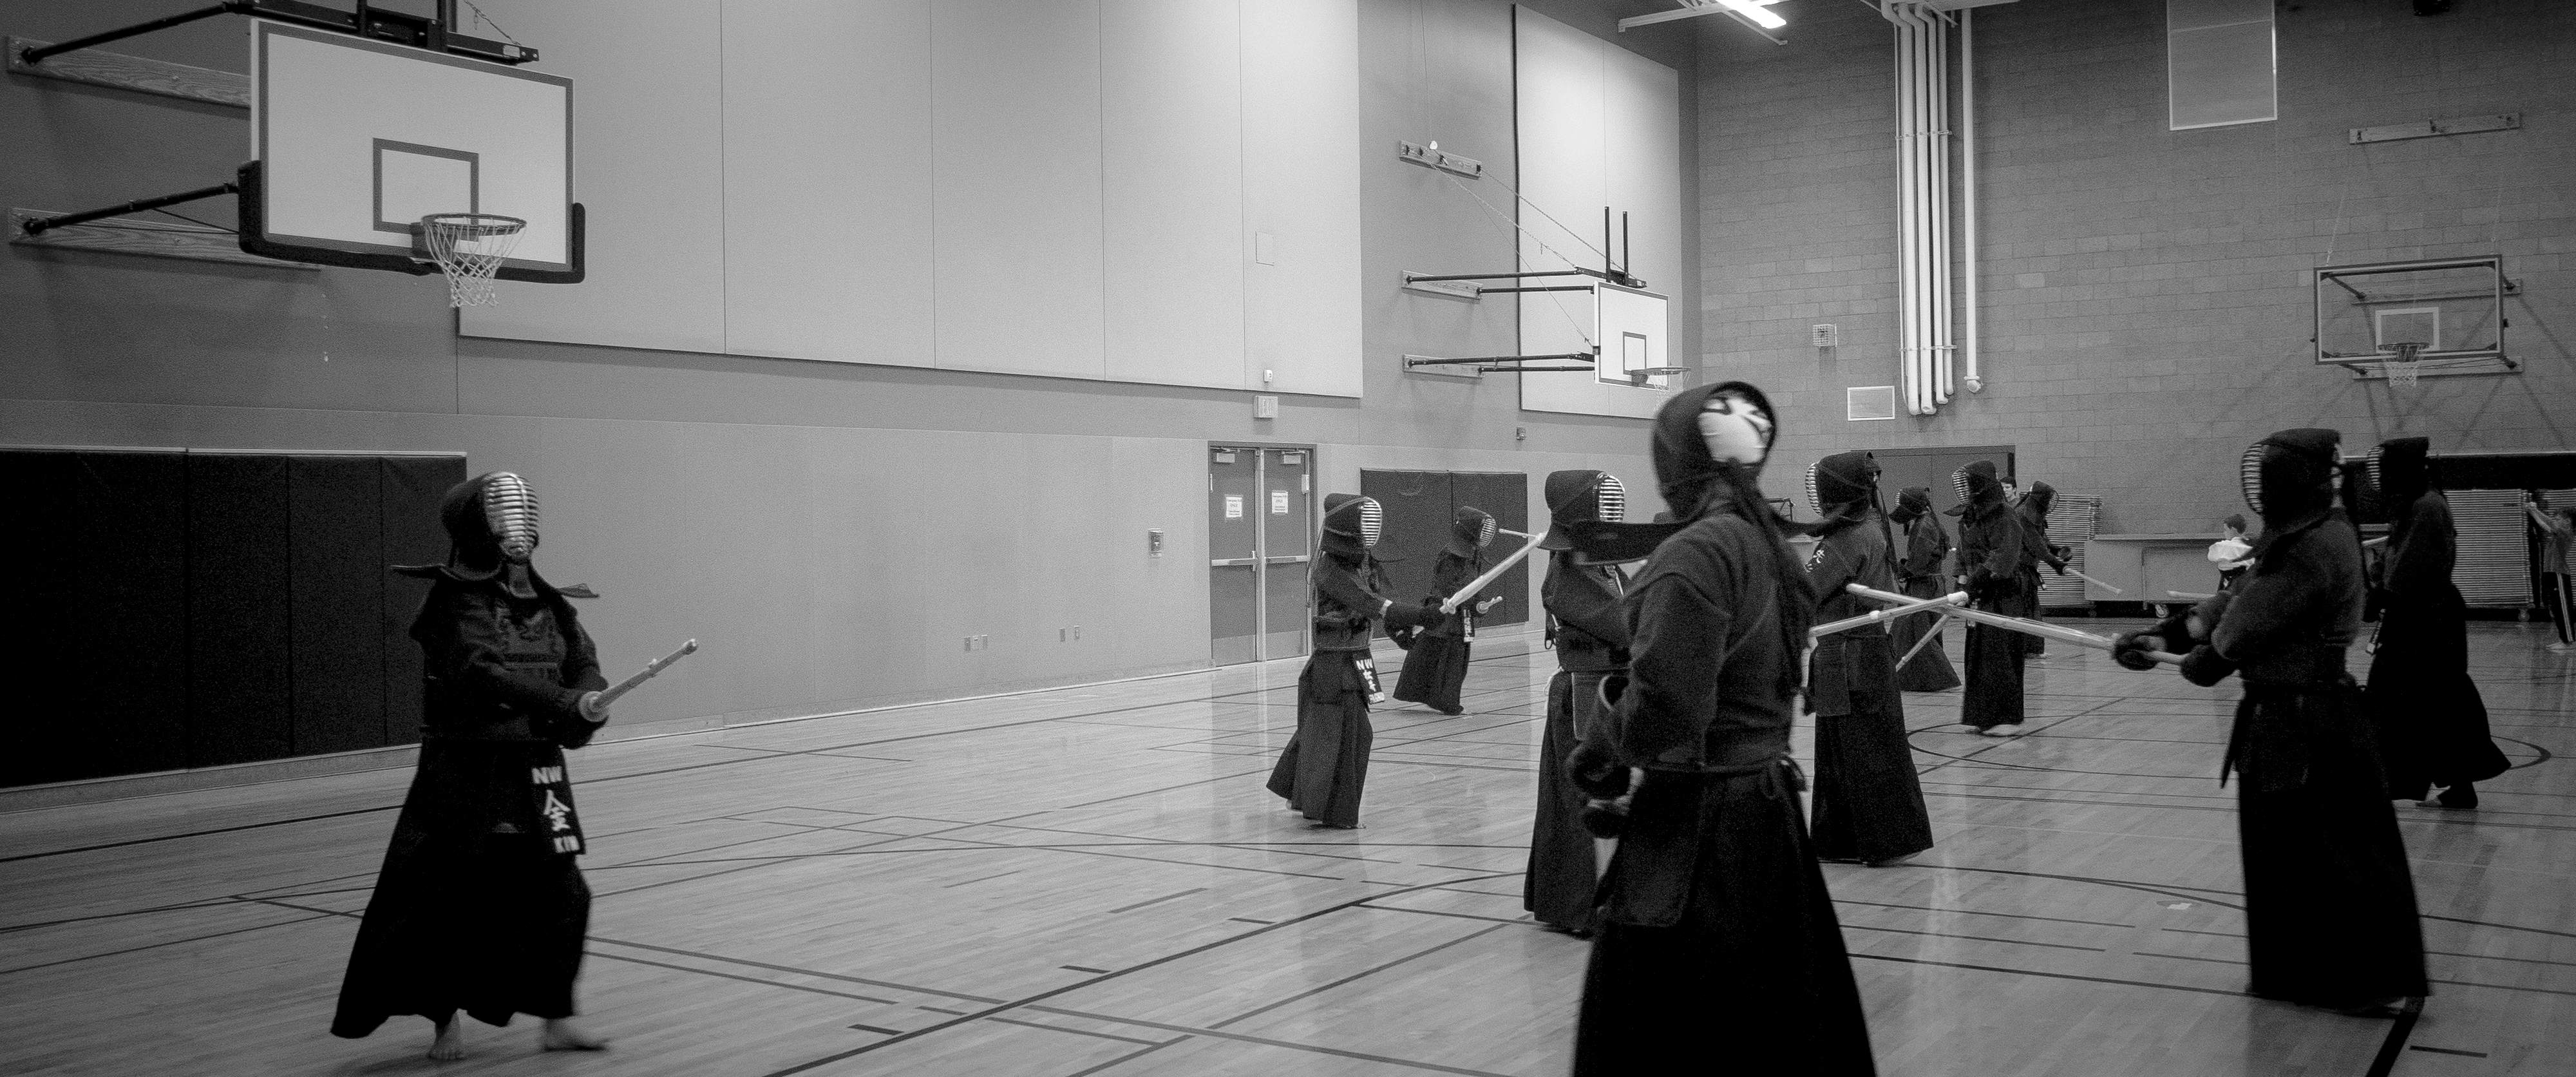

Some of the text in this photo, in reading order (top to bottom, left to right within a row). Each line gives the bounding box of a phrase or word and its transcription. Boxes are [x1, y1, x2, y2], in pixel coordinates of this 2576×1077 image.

[1356, 658, 1373, 671] NW
[531, 766, 562, 784] NW
[544, 790, 571, 832] 金
